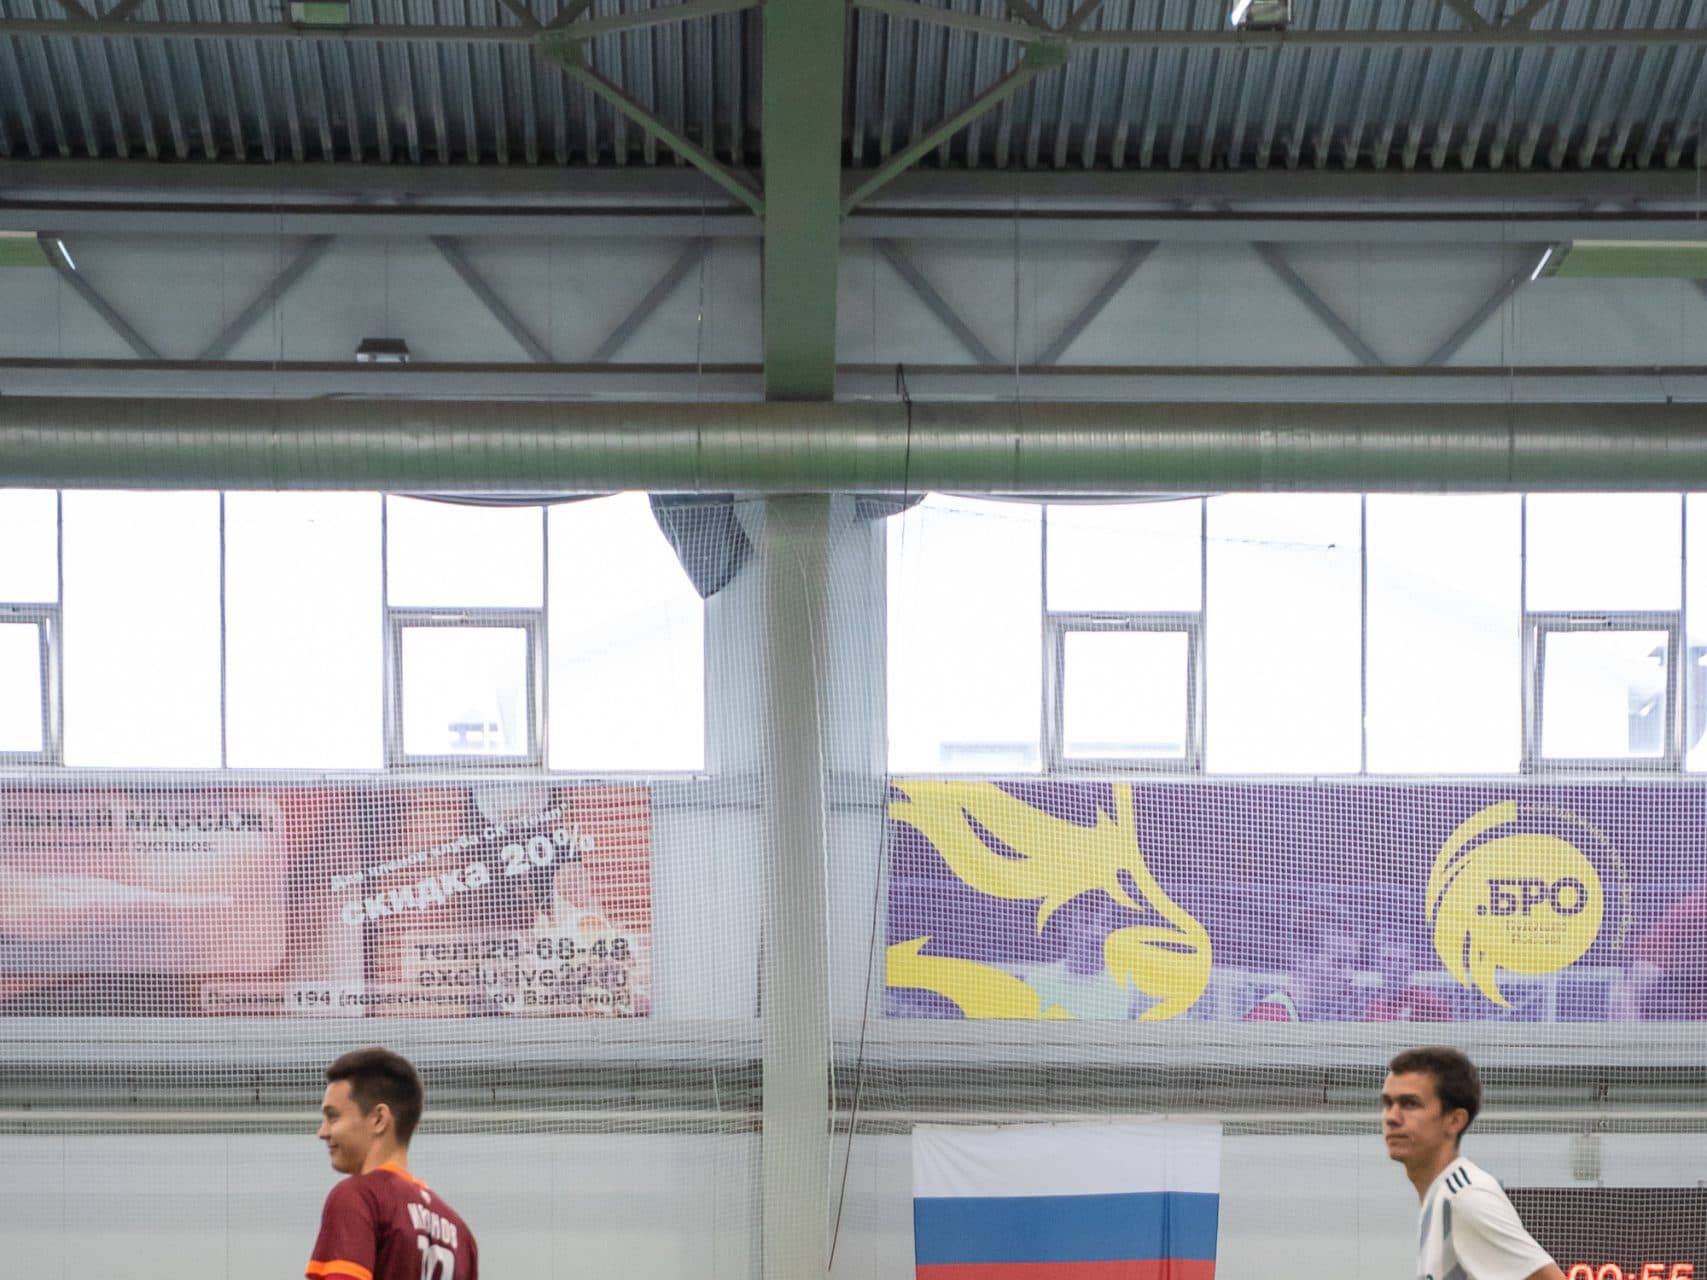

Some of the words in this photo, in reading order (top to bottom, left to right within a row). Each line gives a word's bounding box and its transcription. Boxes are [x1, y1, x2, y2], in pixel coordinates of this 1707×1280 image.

[342, 860, 490, 926] скидка
[500, 823, 595, 876] 20%
[294, 990, 331, 1006] 194
